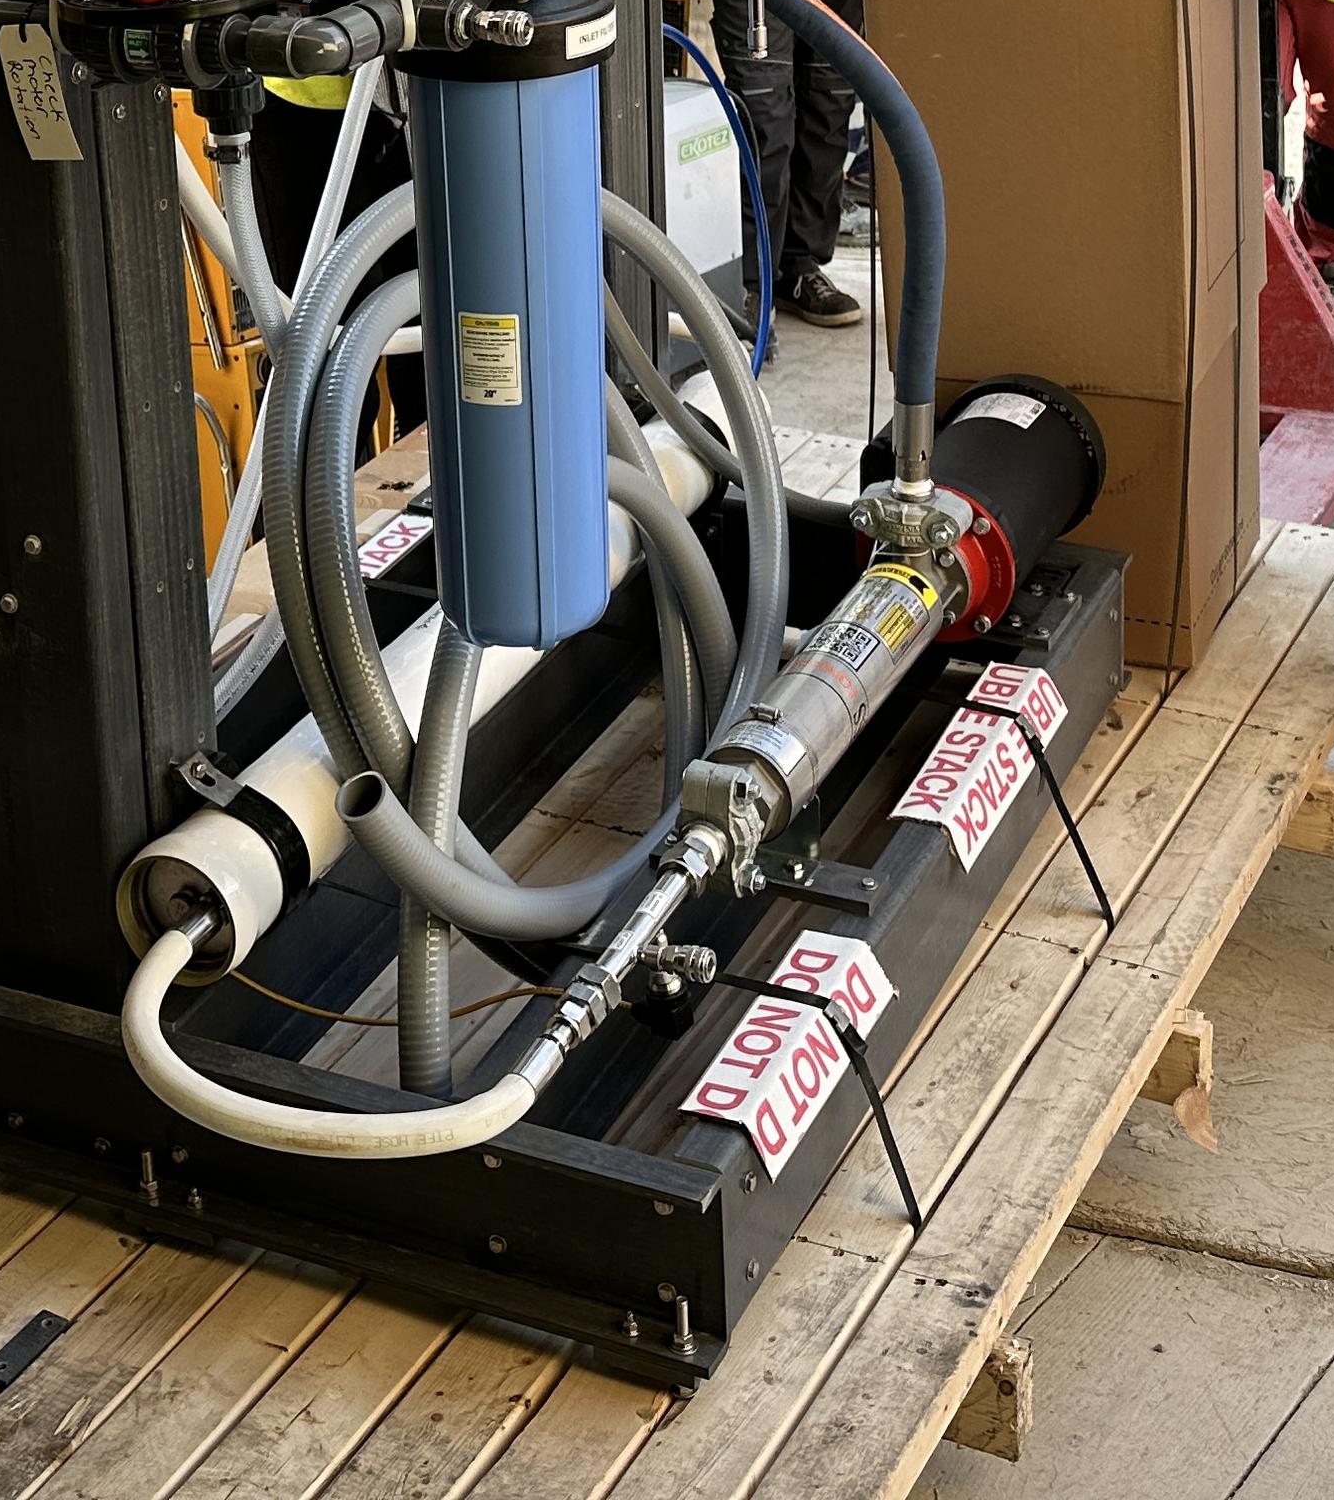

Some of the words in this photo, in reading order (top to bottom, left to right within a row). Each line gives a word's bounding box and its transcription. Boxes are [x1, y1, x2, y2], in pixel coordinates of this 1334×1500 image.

[680, 129, 730, 160] EKOTEZ
[900, 730, 987, 814] STACK
[952, 742, 1018, 856] STACK
[719, 1003, 802, 1079] NOT
[778, 1018, 840, 1126] NOT
[692, 1082, 749, 1118] D
[752, 1097, 788, 1161] D
